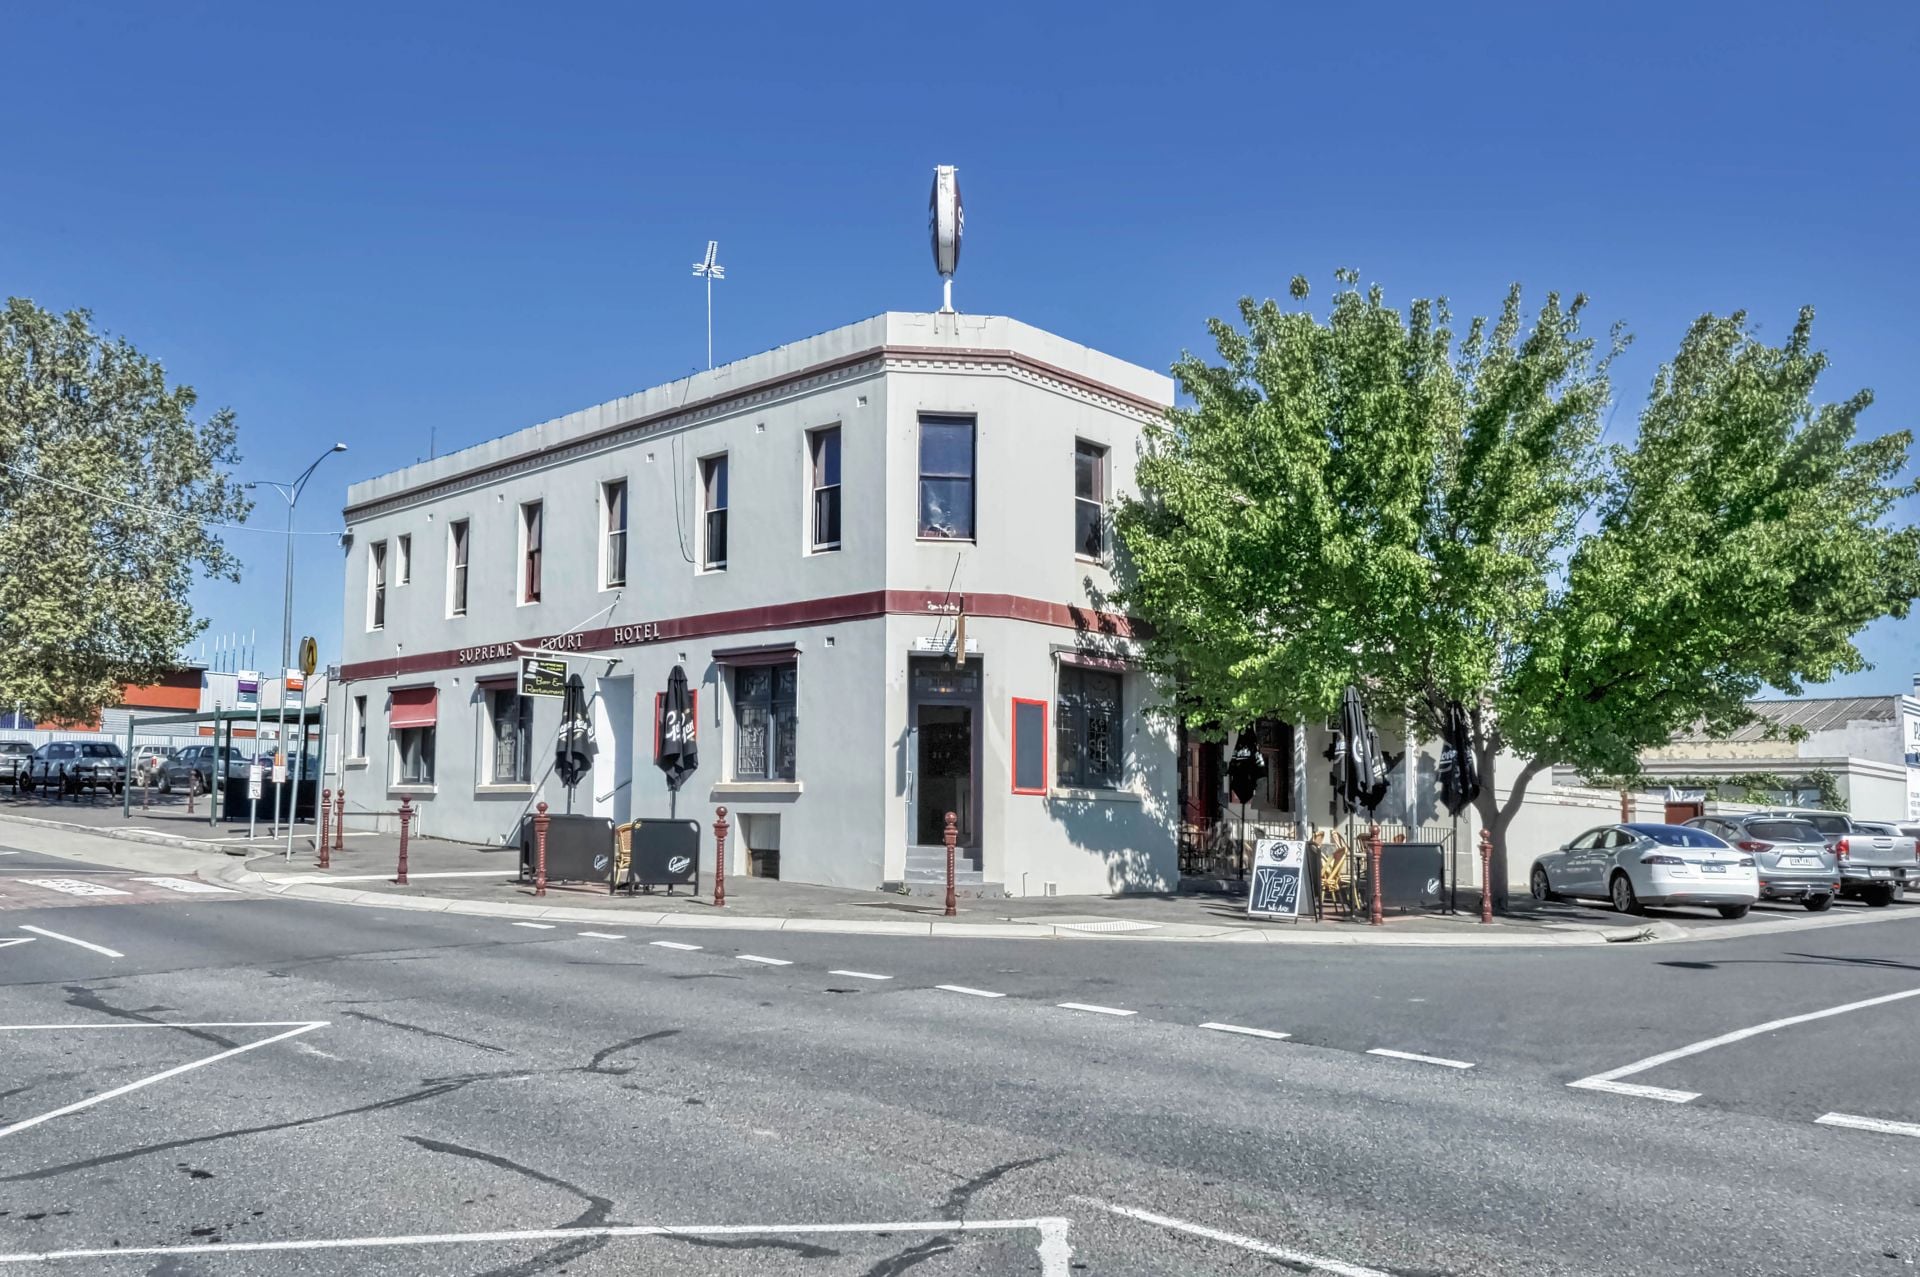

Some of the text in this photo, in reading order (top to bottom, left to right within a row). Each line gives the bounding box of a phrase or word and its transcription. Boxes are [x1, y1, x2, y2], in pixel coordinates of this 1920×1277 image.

[459, 622, 661, 662] SUPREME COURT HOTEL
